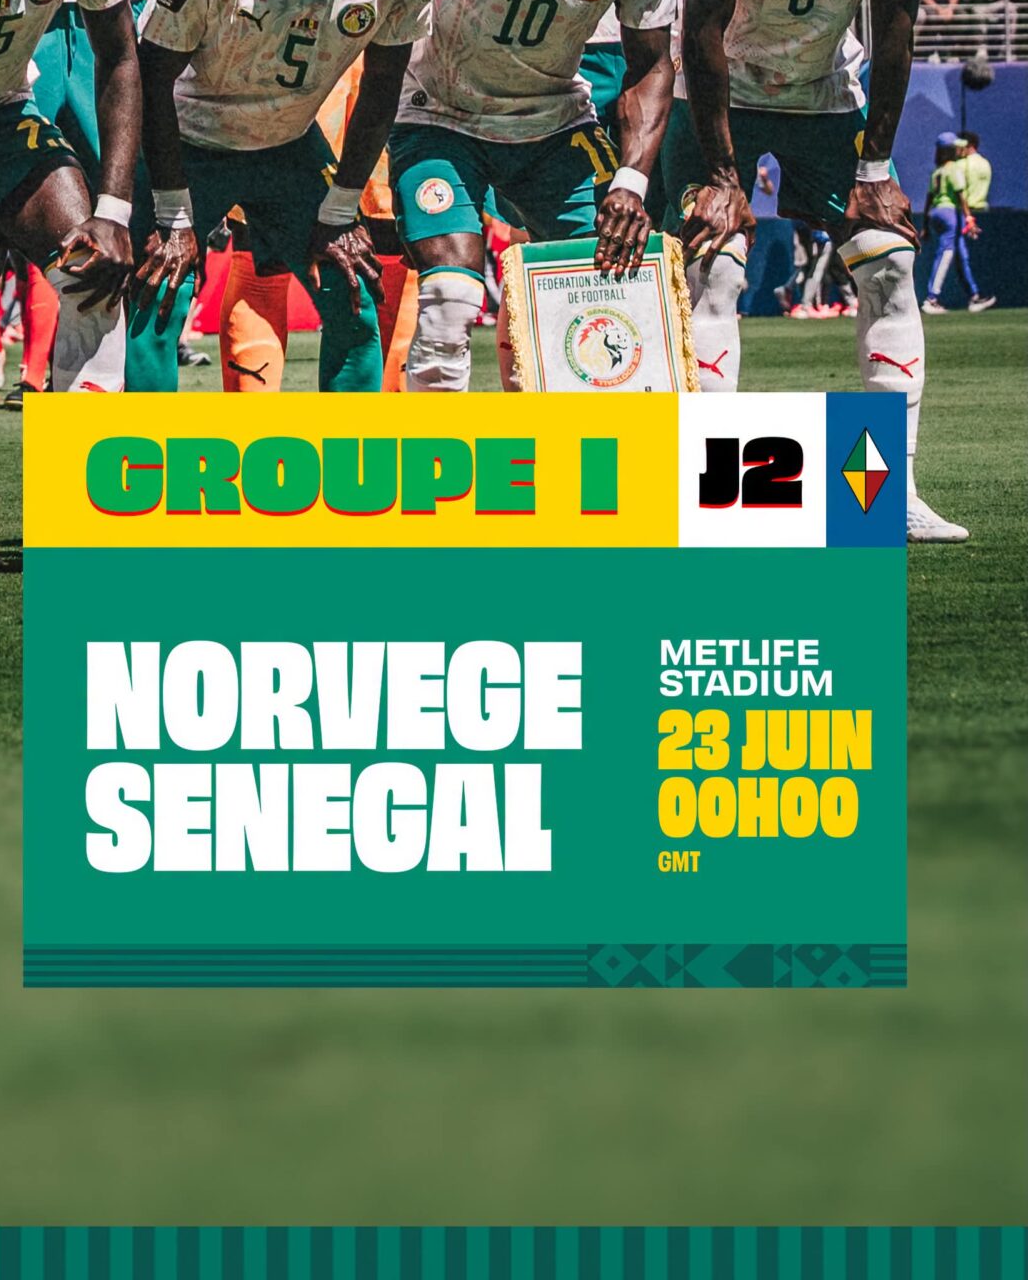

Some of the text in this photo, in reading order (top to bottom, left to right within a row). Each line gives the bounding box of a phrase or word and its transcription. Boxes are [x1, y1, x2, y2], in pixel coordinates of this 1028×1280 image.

[275, 34, 316, 88] 5
[537, 274, 591, 291] FÉDÉRATION
[568, 288, 627, 304] DE FOOTBALL
